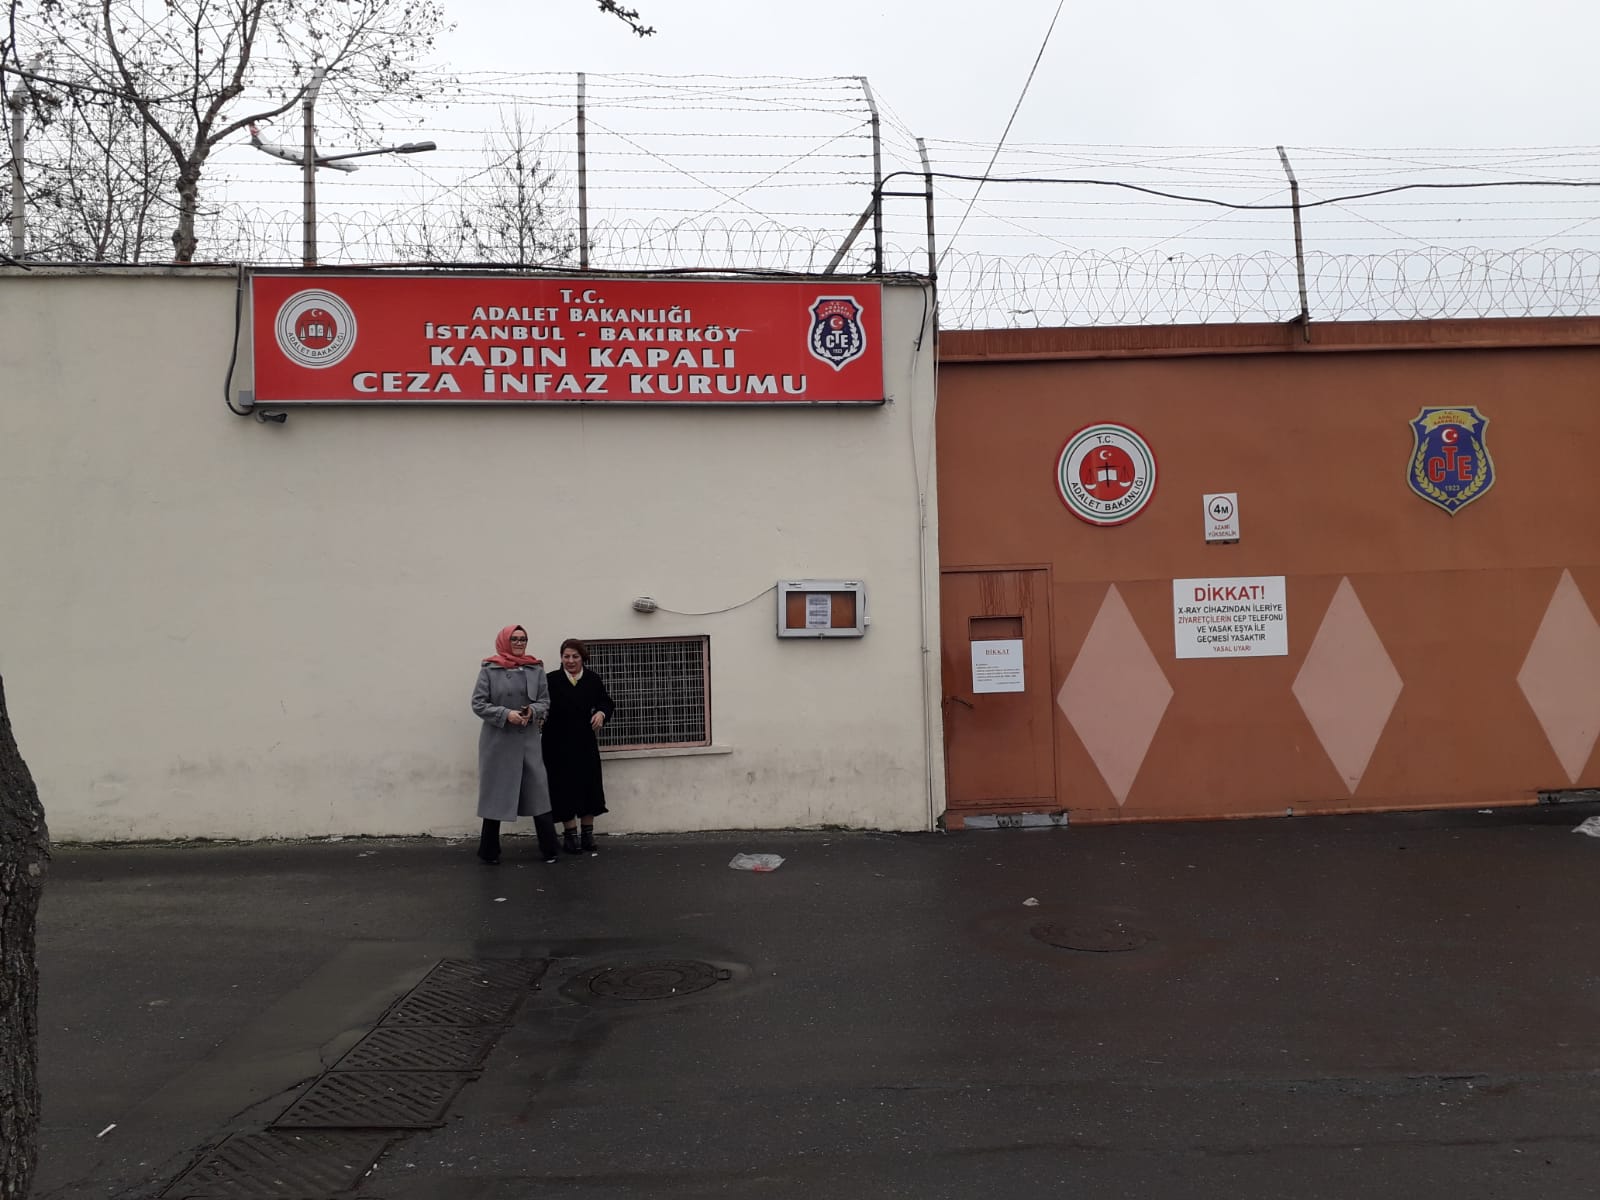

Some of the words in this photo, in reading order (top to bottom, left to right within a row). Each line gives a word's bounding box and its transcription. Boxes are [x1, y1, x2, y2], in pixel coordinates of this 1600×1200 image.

[560, 289, 605, 304] T.C.
[472, 306, 559, 321] ADALET
[569, 305, 691, 323] BAKANLIĞI
[424, 322, 565, 340] İSTANBUL
[599, 325, 740, 342] BAKIRKÖY
[429, 346, 567, 367] KADIN
[589, 347, 735, 368] KAPALI
[352, 371, 461, 393] CEZA
[483, 368, 608, 394] İNFAZ
[630, 373, 807, 394] KURUMU
[1096, 436, 1114, 444] T.C.
[1428, 445, 1473, 483] CTE
[1071, 482, 1101, 510] ADALET
[1194, 584, 1265, 602] DİKKAT!
[1178, 606, 1202, 614] X-RAY
[1203, 604, 1251, 613] CİHAZINDAN
[1252, 603, 1283, 612] İLERİYE
[1178, 615, 1232, 624] ZİYARETÇİLERİN
[1233, 614, 1247, 622] CEP
[1248, 613, 1283, 622] TELEFONU
[1197, 625, 1207, 633] VE
[1208, 624, 1233, 633] YASAK
[1234, 624, 1253, 633] EŞYA
[1254, 623, 1266, 631] İLE
[1197, 634, 1230, 643] GEÇMESİ
[1230, 633, 1266, 642] YASAKTIR
